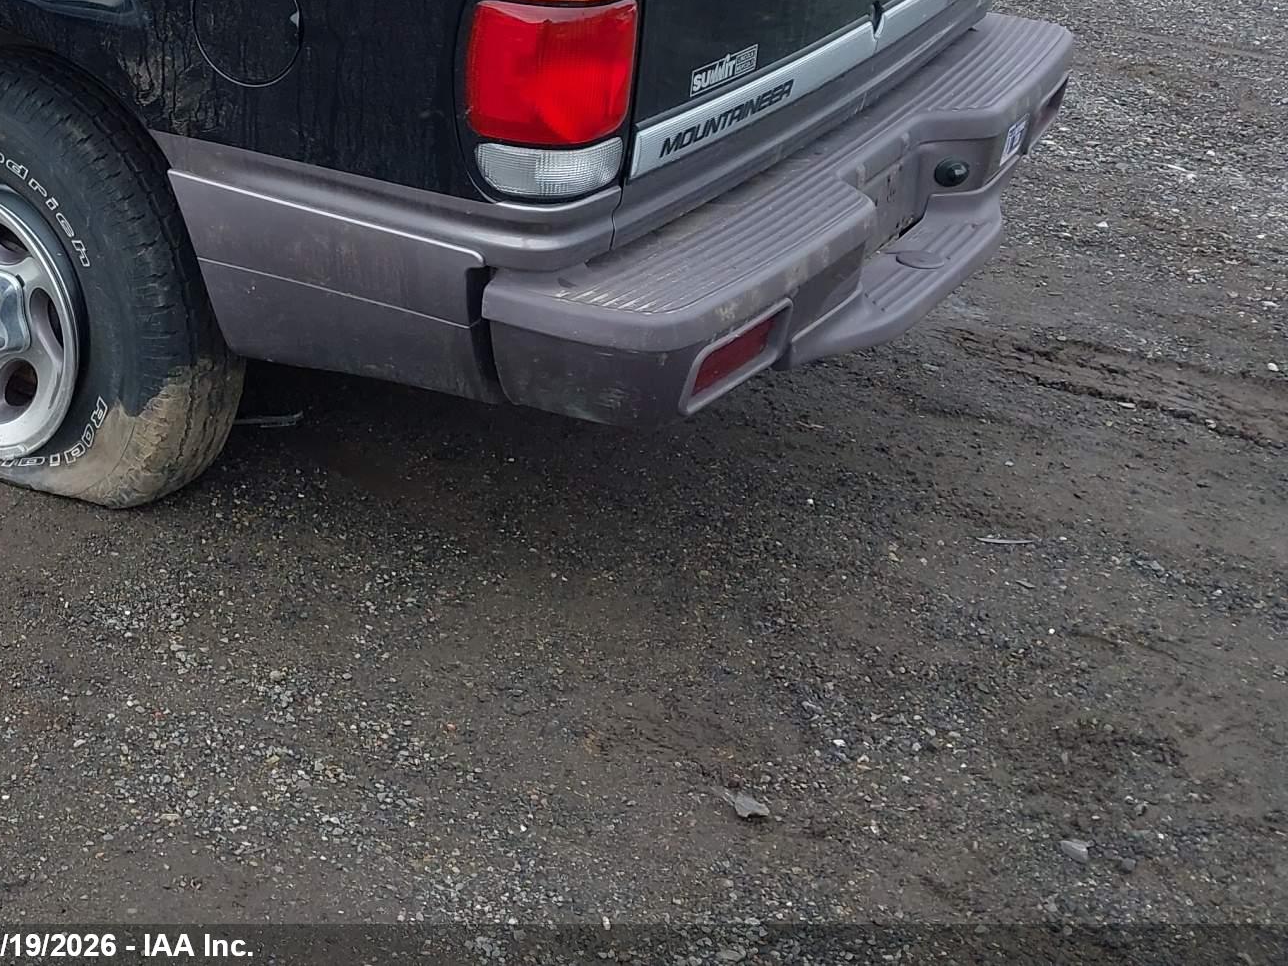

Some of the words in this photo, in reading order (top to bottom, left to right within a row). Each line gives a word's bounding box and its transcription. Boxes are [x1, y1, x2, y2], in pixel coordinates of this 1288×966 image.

[692, 53, 736, 92] SUMMIT
[659, 79, 794, 158] MOUNTAINEER
[1, 396, 109, 467] Radial
